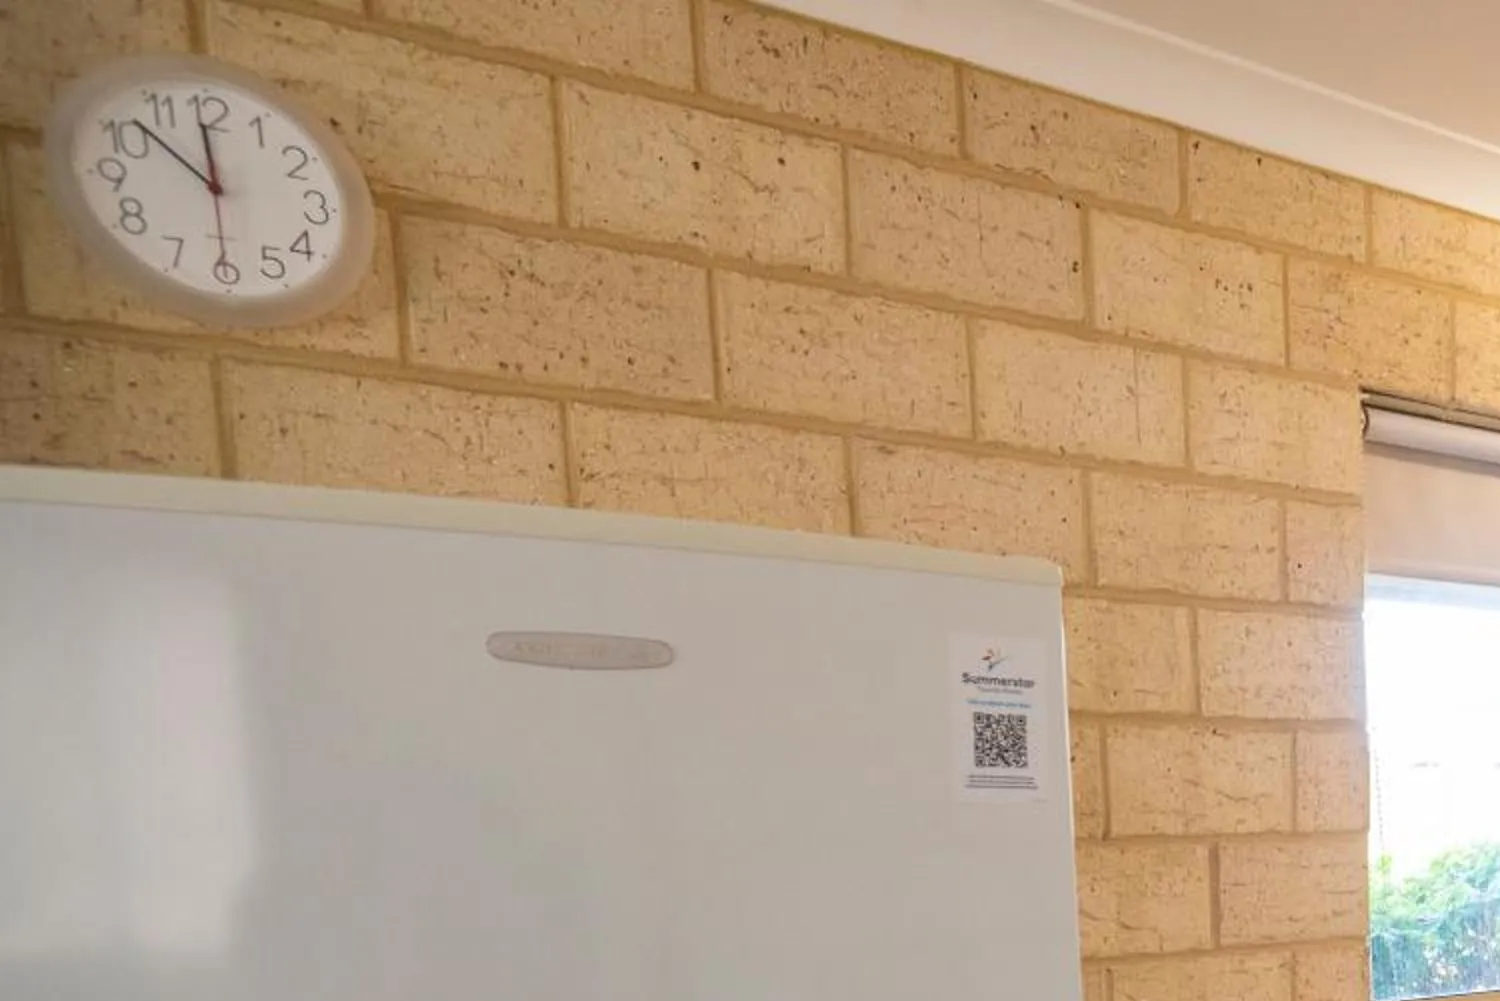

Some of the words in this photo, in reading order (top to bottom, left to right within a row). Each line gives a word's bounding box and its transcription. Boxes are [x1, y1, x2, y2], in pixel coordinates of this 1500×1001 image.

[145, 93, 175, 128] 11
[187, 94, 230, 133] 12
[101, 119, 149, 159] 10
[249, 116, 264, 148] 1
[97, 156, 127, 192] 9
[281, 145, 309, 180] 2
[119, 197, 147, 235] 8
[303, 190, 329, 225] 3
[161, 235, 184, 268] 7
[260, 246, 285, 280] 5
[289, 230, 314, 262] 4
[213, 252, 240, 284] 6
